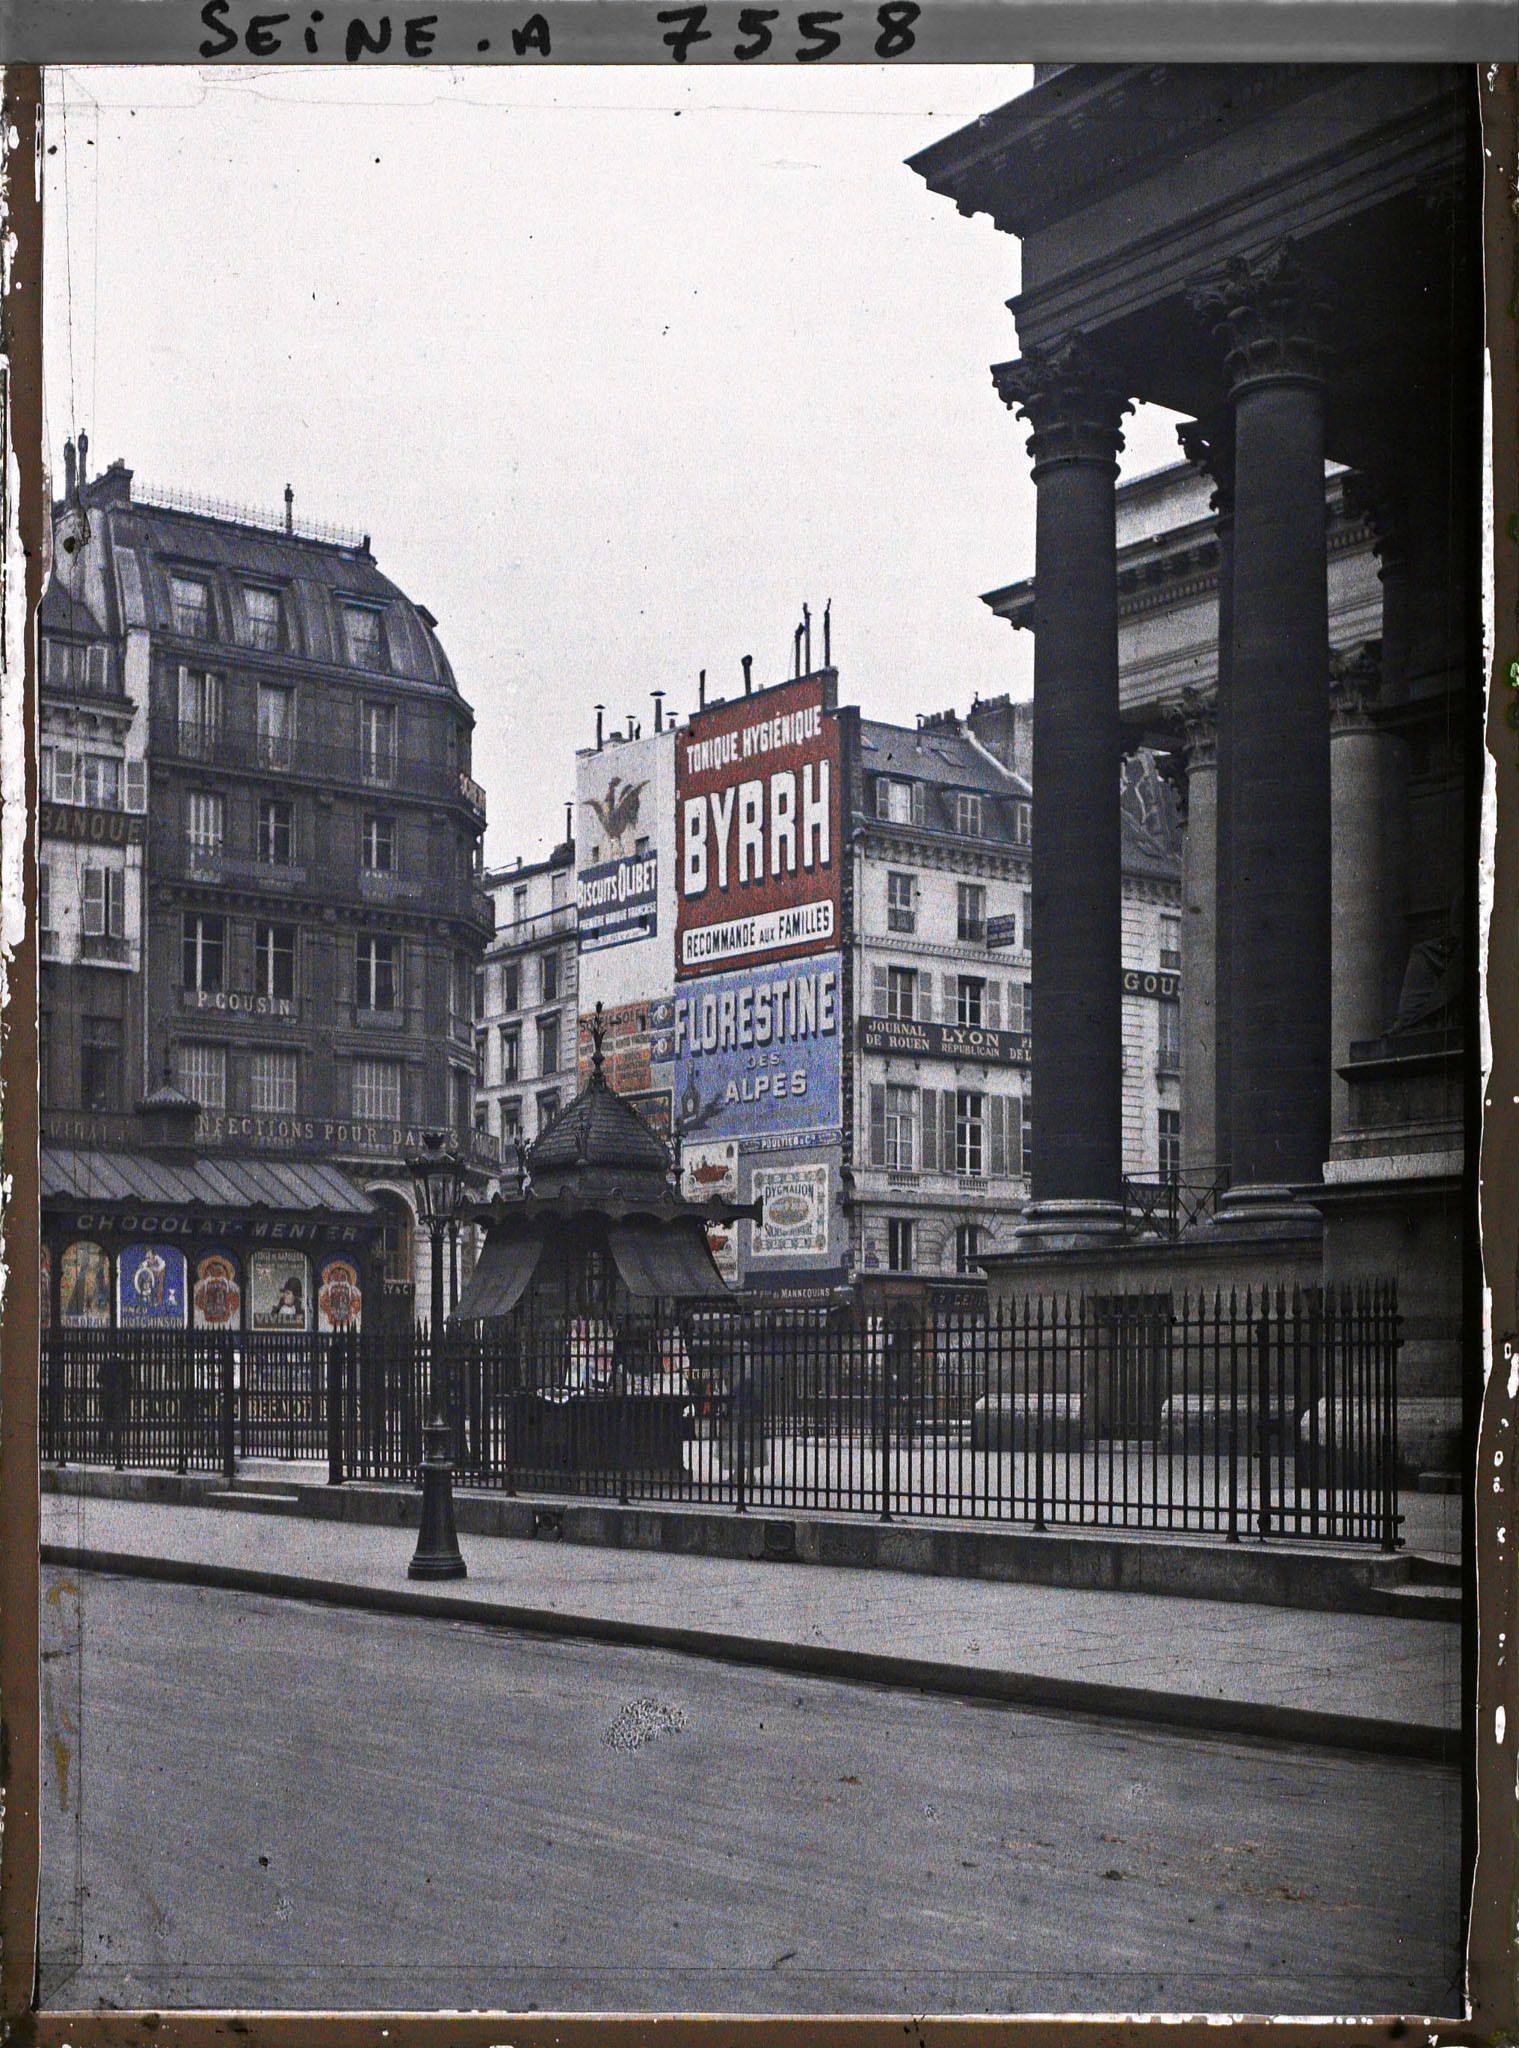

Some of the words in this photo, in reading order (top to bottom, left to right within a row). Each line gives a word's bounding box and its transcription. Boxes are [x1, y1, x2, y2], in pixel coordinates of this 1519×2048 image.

[657, 1, 922, 62] 7558
[684, 759, 830, 897] BYRRH
[618, 859, 657, 902] OLIBET
[687, 918, 755, 959] RECOMMANDÉ
[759, 925, 775, 940] AUX
[779, 905, 830, 940] FAMILLES
[1123, 972, 1181, 996] GOU
[215, 992, 290, 1016] COUSIN
[675, 970, 835, 1055] FLORESTINE
[868, 1020, 926, 1038] JOURNAL
[941, 1027, 1000, 1048] LYON
[866, 1033, 882, 1047] DE
[889, 1035, 930, 1051] ROUEN
[747, 1052, 780, 1069] DES
[725, 1070, 808, 1104] ALPES
[199, 1113, 315, 1140] NFECTIONS
[325, 1123, 377, 1144] POUR
[392, 1130, 459, 1150] DAS
[765, 1184, 814, 1205] PYGMALION
[251, 1222, 359, 1241] MENIER
[122, 1316, 183, 1329] HUTCHINSON
